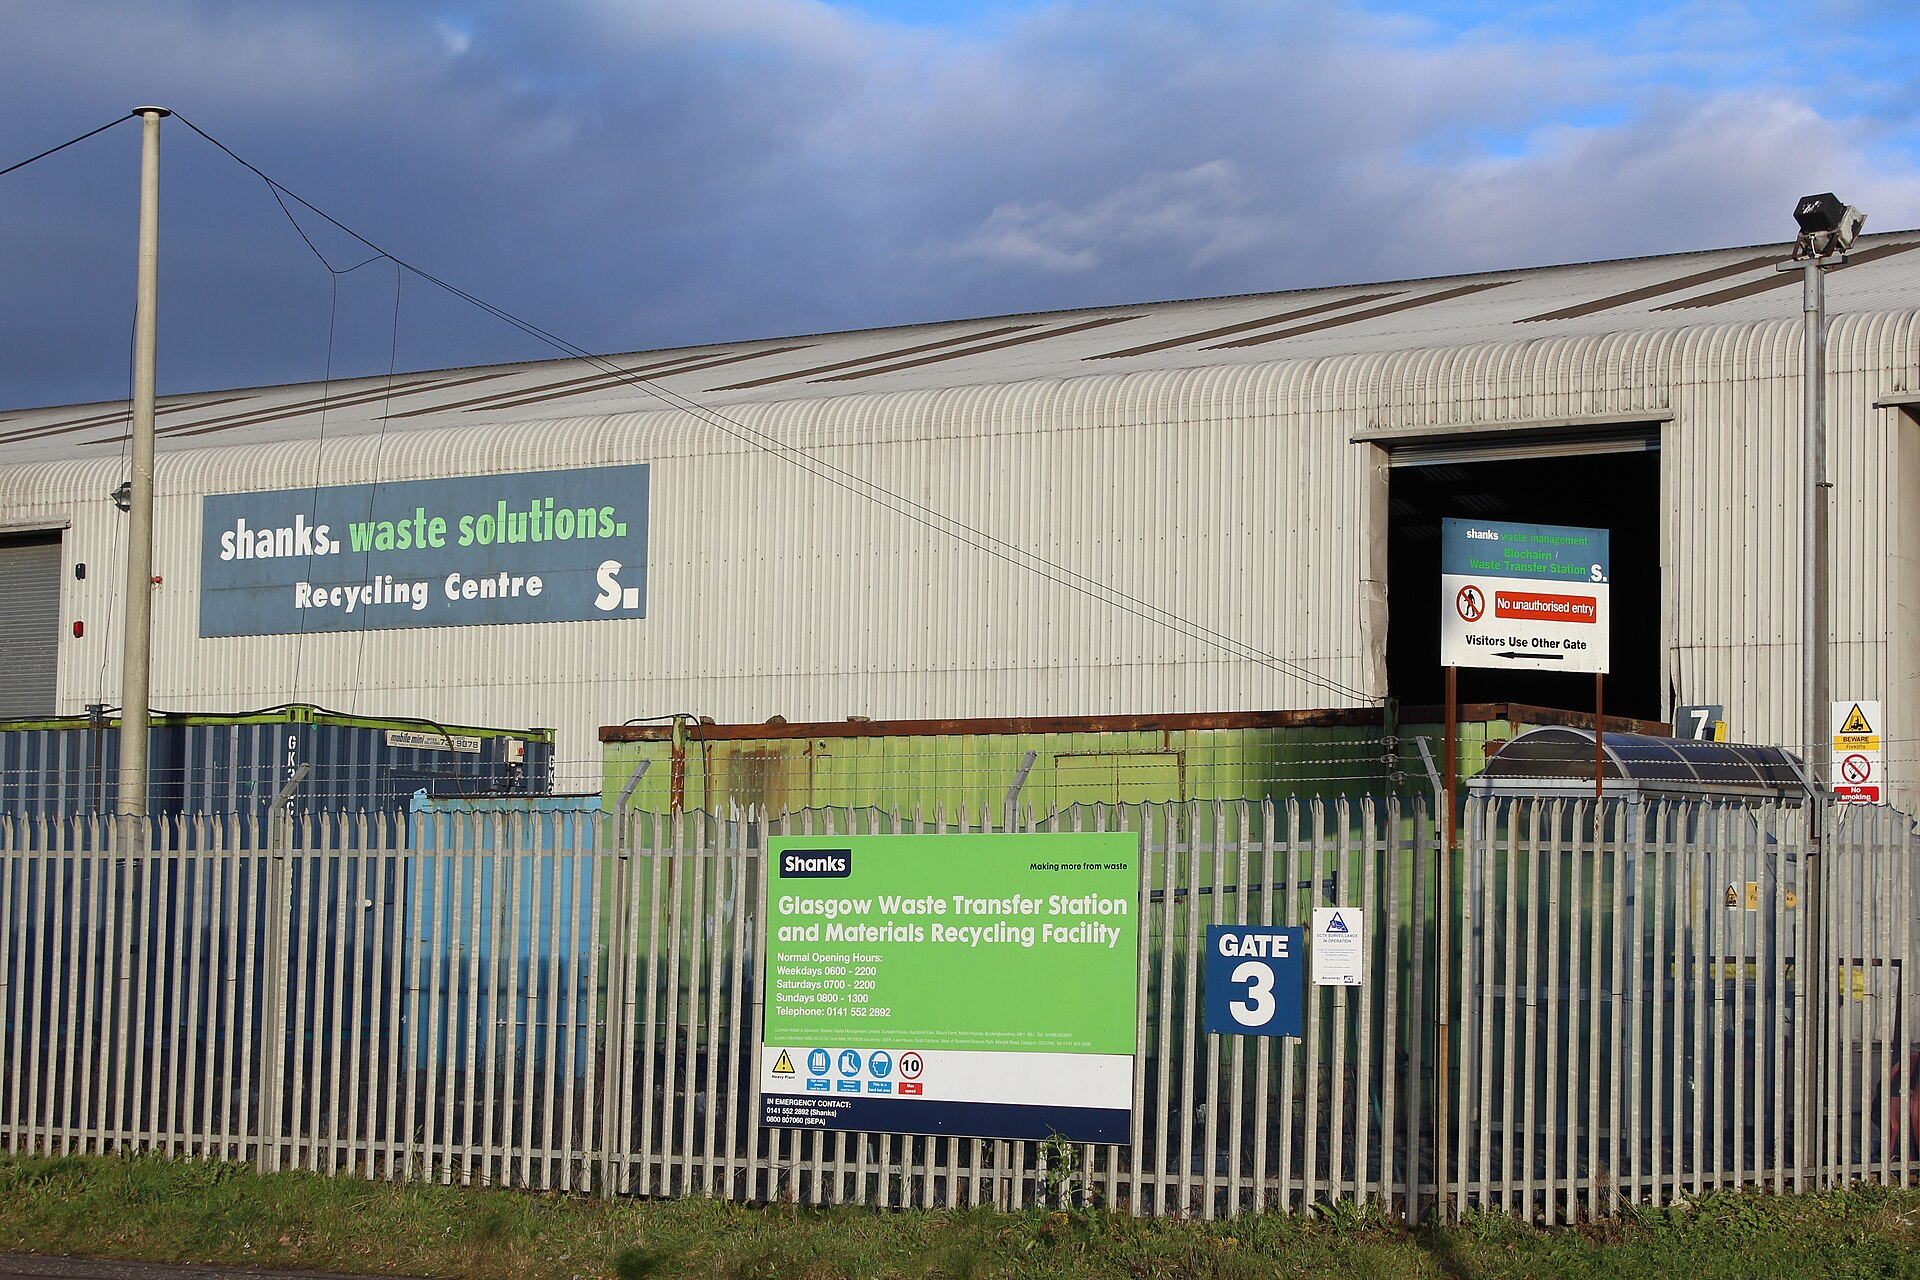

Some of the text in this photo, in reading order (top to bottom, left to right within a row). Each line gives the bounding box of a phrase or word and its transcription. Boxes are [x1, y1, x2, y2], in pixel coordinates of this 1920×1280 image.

[219, 497, 627, 561] shanks. waste solutions.
[1466, 528, 1589, 547] shanks waste management
[1503, 548, 1552, 561] Blochairn
[1469, 559, 1586, 575] Waste Transfer Station
[295, 572, 543, 613] Recycling Centre
[1497, 597, 1594, 617] No unauthorised entry
[1465, 634, 1587, 650] Visitors Use Other Gate
[1690, 709, 1709, 740] 7
[391, 732, 425, 744] mobile mini
[1841, 792, 1871, 801] smoking
[785, 855, 846, 872] Shanks
[1029, 862, 1059, 871] Making
[1083, 862, 1102, 870] from
[1103, 862, 1128, 870] waste
[778, 892, 1127, 919] Glasgow Waste Transfer Station
[778, 920, 1121, 948] and Materials Recycling Facility
[1218, 933, 1289, 958] GATE
[777, 953, 883, 964] Normal Opening Hours:
[776, 966, 822, 977] Weekdays
[824, 966, 846, 976] 0600
[854, 966, 877, 976] 2200
[776, 979, 821, 990] Saturdays
[823, 979, 845, 989] 0700
[853, 980, 876, 990] 2200
[776, 993, 814, 1004] Sundays
[816, 993, 838, 1003] 0800
[847, 993, 869, 1003] 1300
[1229, 960, 1276, 1027] 3
[776, 1006, 891, 1017] Telephone: 0141 552 2892
[902, 1060, 920, 1072] 10
[775, 1098, 817, 1107] EMERGENCY
[817, 1100, 852, 1108] CONTACT:
[766, 1106, 837, 1118] 0141 552 2892 (Shanks)
[766, 1115, 781, 1123] 0800
[804, 1117, 826, 1126] (SEPA)
